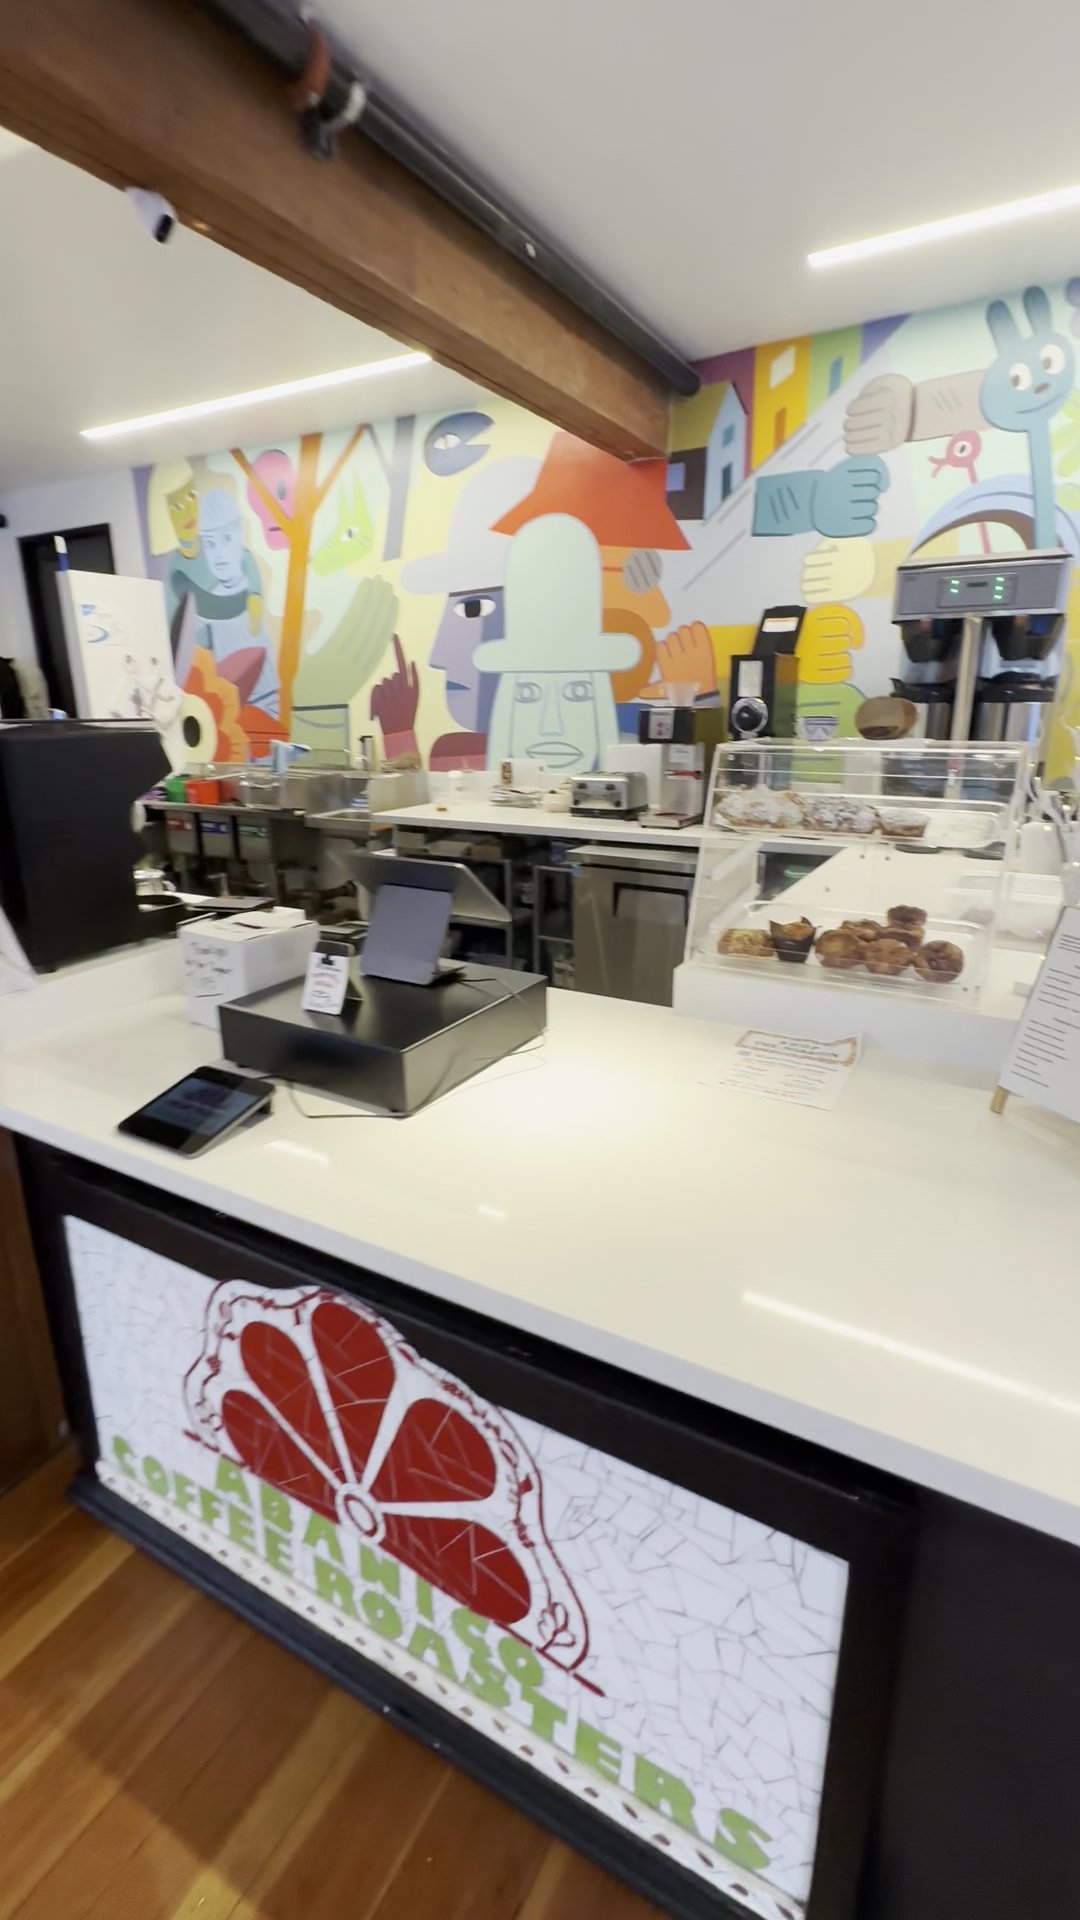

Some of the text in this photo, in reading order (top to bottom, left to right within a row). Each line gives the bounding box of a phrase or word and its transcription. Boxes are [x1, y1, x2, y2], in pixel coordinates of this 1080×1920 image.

[111, 1434, 774, 1870] COFFEE ROASTERS
[214, 1456, 544, 1688] ABANICO
